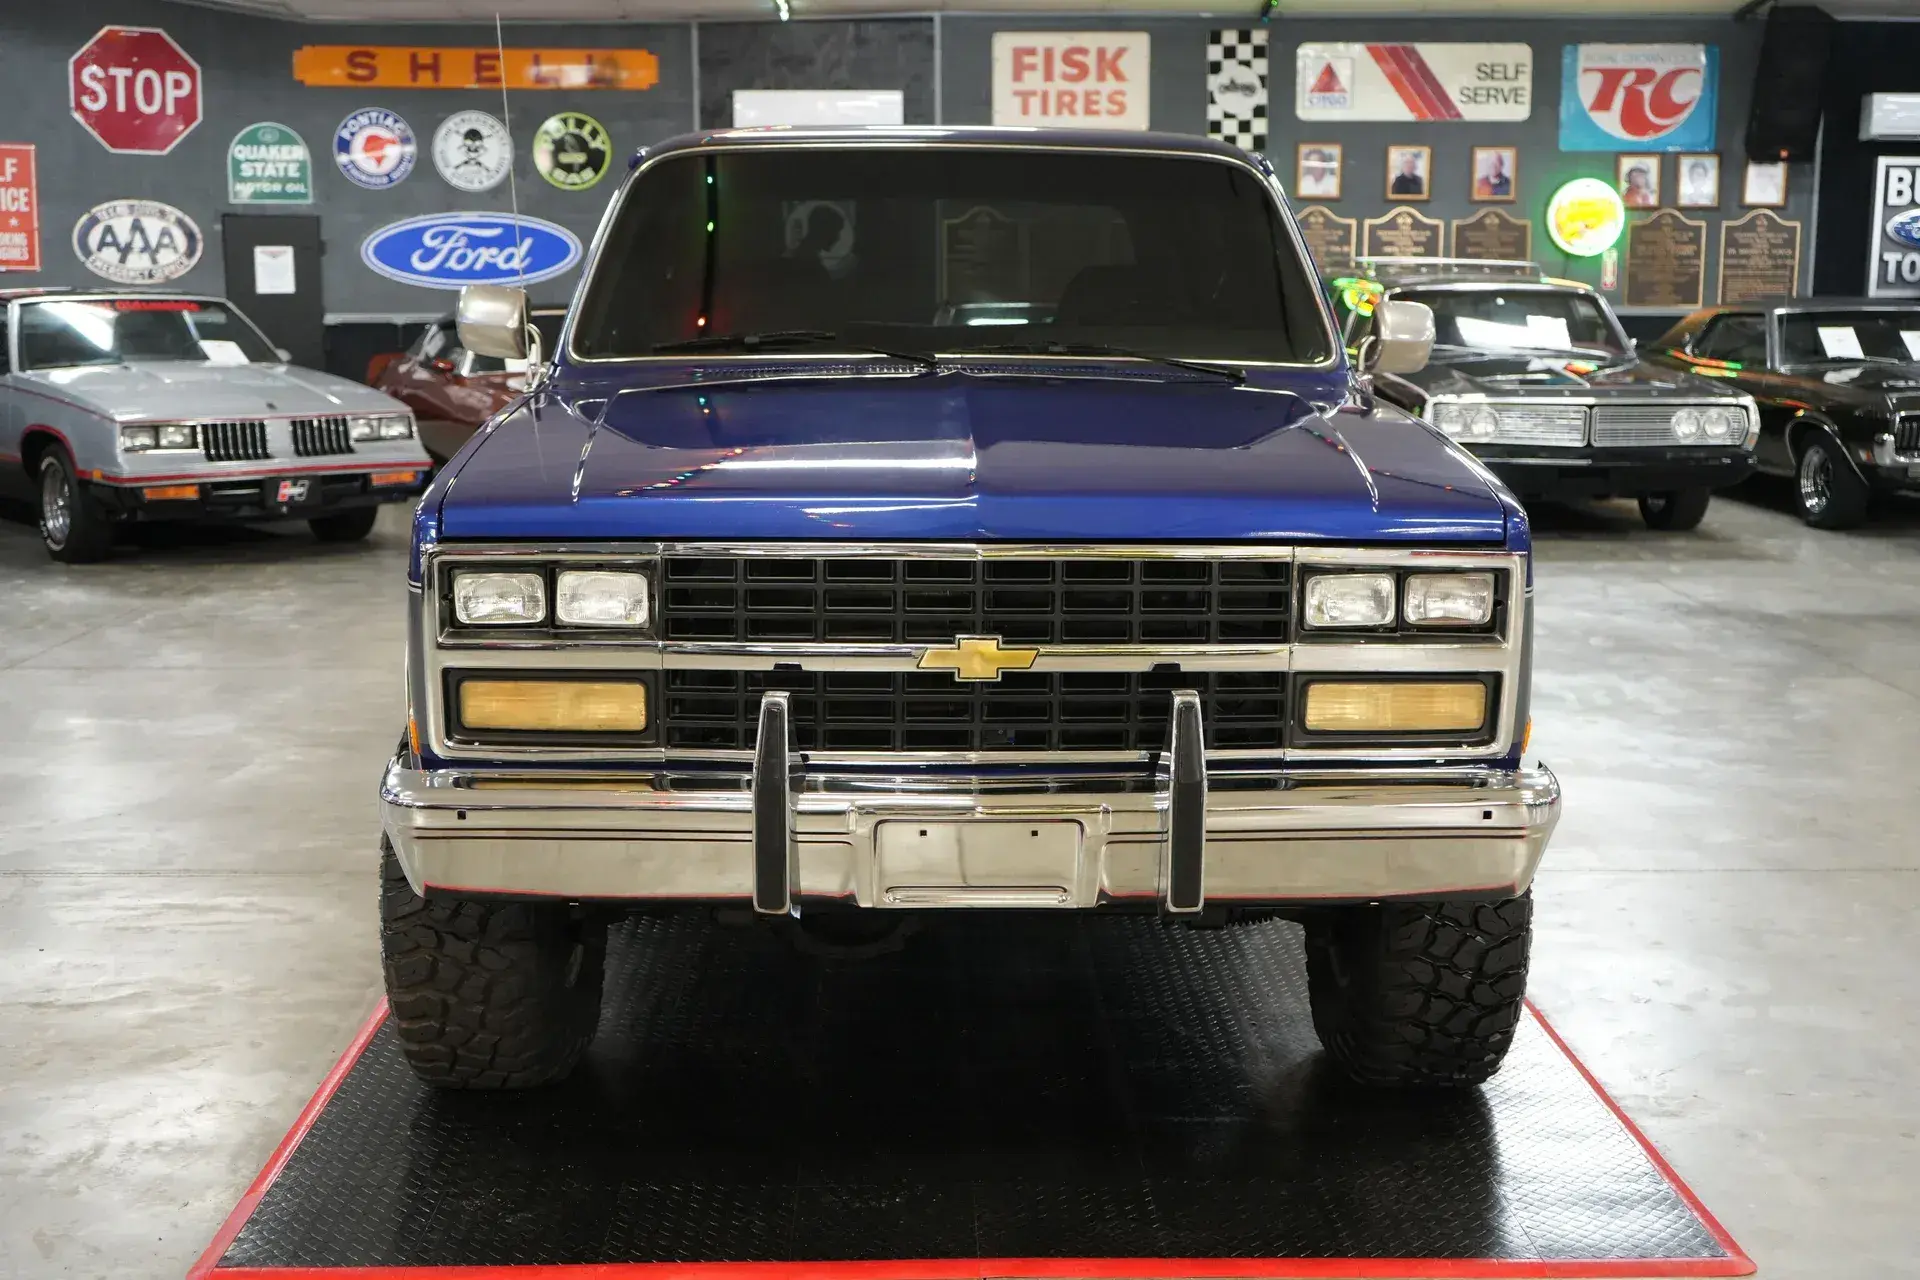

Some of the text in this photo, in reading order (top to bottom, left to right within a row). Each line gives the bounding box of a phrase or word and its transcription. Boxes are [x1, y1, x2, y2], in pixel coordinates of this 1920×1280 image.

[1012, 46, 1129, 82] FISK
[1475, 62, 1527, 81] SELF
[80, 64, 192, 115] STOP
[1012, 89, 1127, 116] TIRES
[1459, 87, 1527, 105] SERVE
[1582, 67, 1702, 137] RC
[340, 111, 407, 140] PONTIAC
[234, 144, 304, 161] QUAKER
[239, 161, 300, 178] STATE
[552, 166, 596, 184] GAS
[234, 182, 308, 194] MOTOR OIL
[96, 217, 179, 265] AAA
[410, 224, 534, 272] Ford
